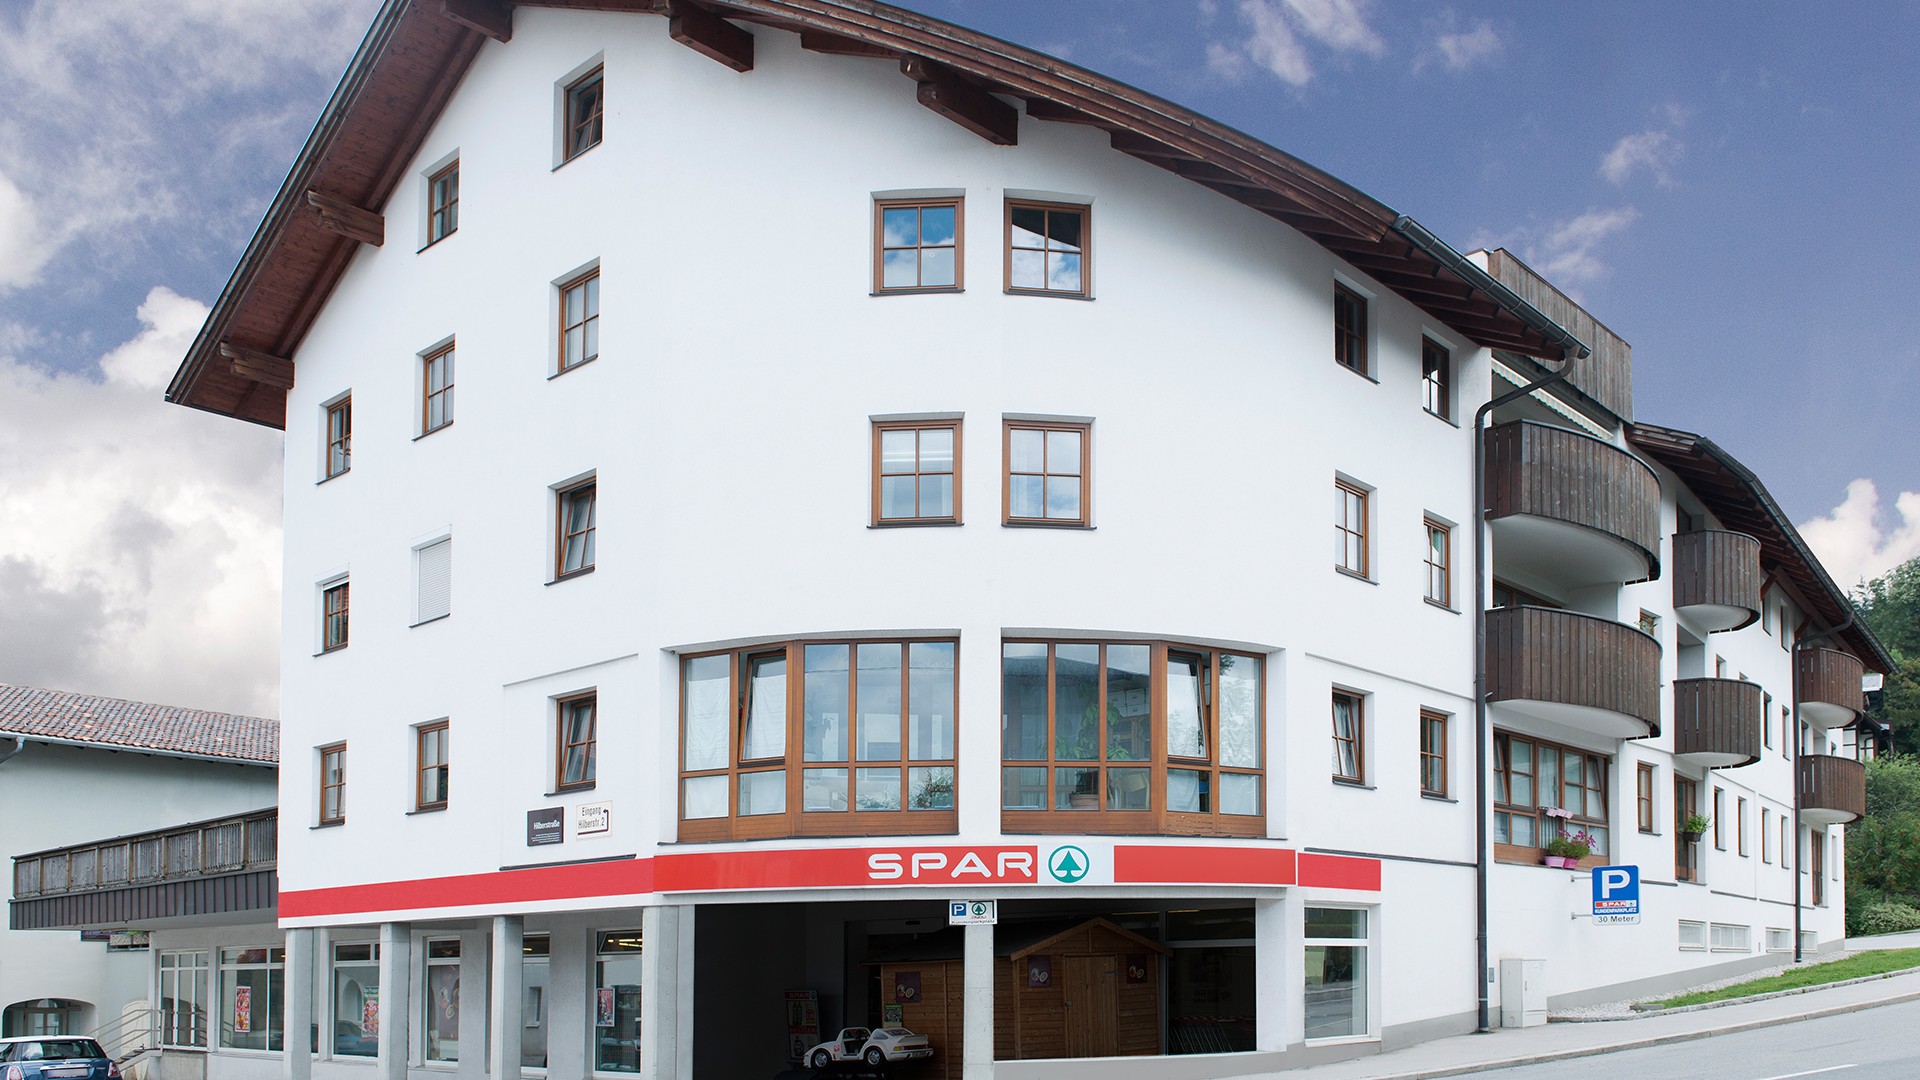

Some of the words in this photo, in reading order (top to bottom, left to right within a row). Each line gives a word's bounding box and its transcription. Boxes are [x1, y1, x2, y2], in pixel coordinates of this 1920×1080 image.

[582, 807, 601, 817] Eingang
[868, 851, 1033, 879] SPAR
[1602, 870, 1630, 899] P
[954, 904, 964, 915] P
